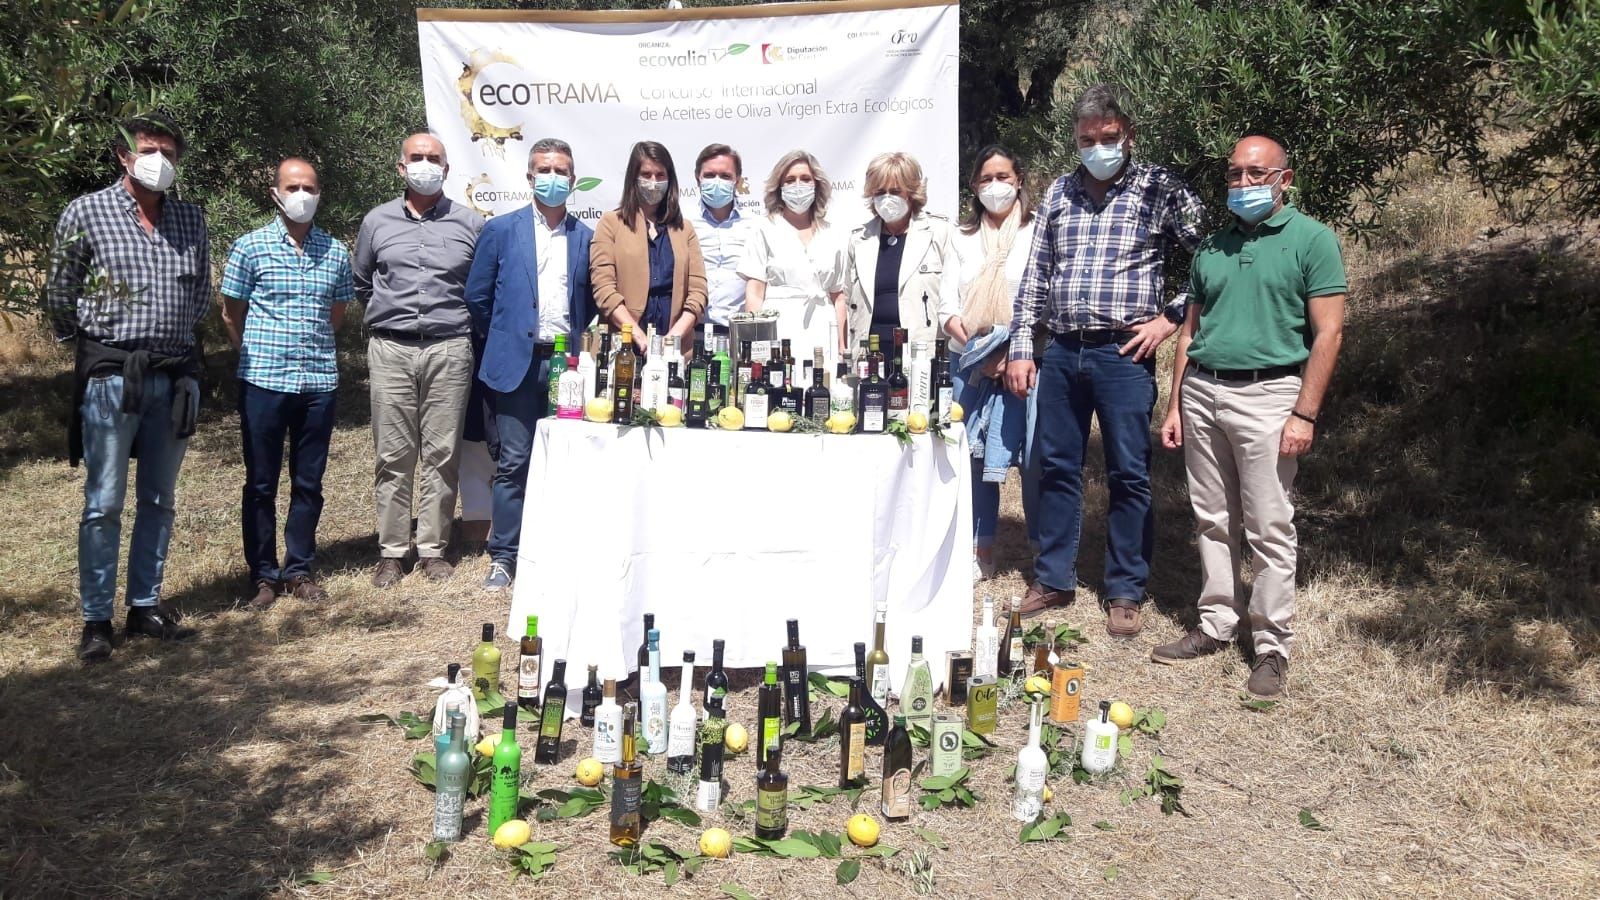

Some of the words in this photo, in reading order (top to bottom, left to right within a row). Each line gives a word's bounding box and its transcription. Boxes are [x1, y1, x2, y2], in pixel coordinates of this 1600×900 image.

[639, 50, 707, 67] ecovalia
[786, 45, 828, 55] Diputación
[479, 82, 621, 106] ecoTRAMA
[640, 85, 712, 100] Concurso
[721, 77, 817, 98] Internacional
[639, 106, 658, 121] de
[662, 105, 711, 121] Aceites
[714, 104, 733, 119] de
[736, 103, 771, 119] Oliva
[776, 101, 821, 119] Virgen
[825, 100, 858, 115] Extra
[864, 97, 934, 115] Ecológicos
